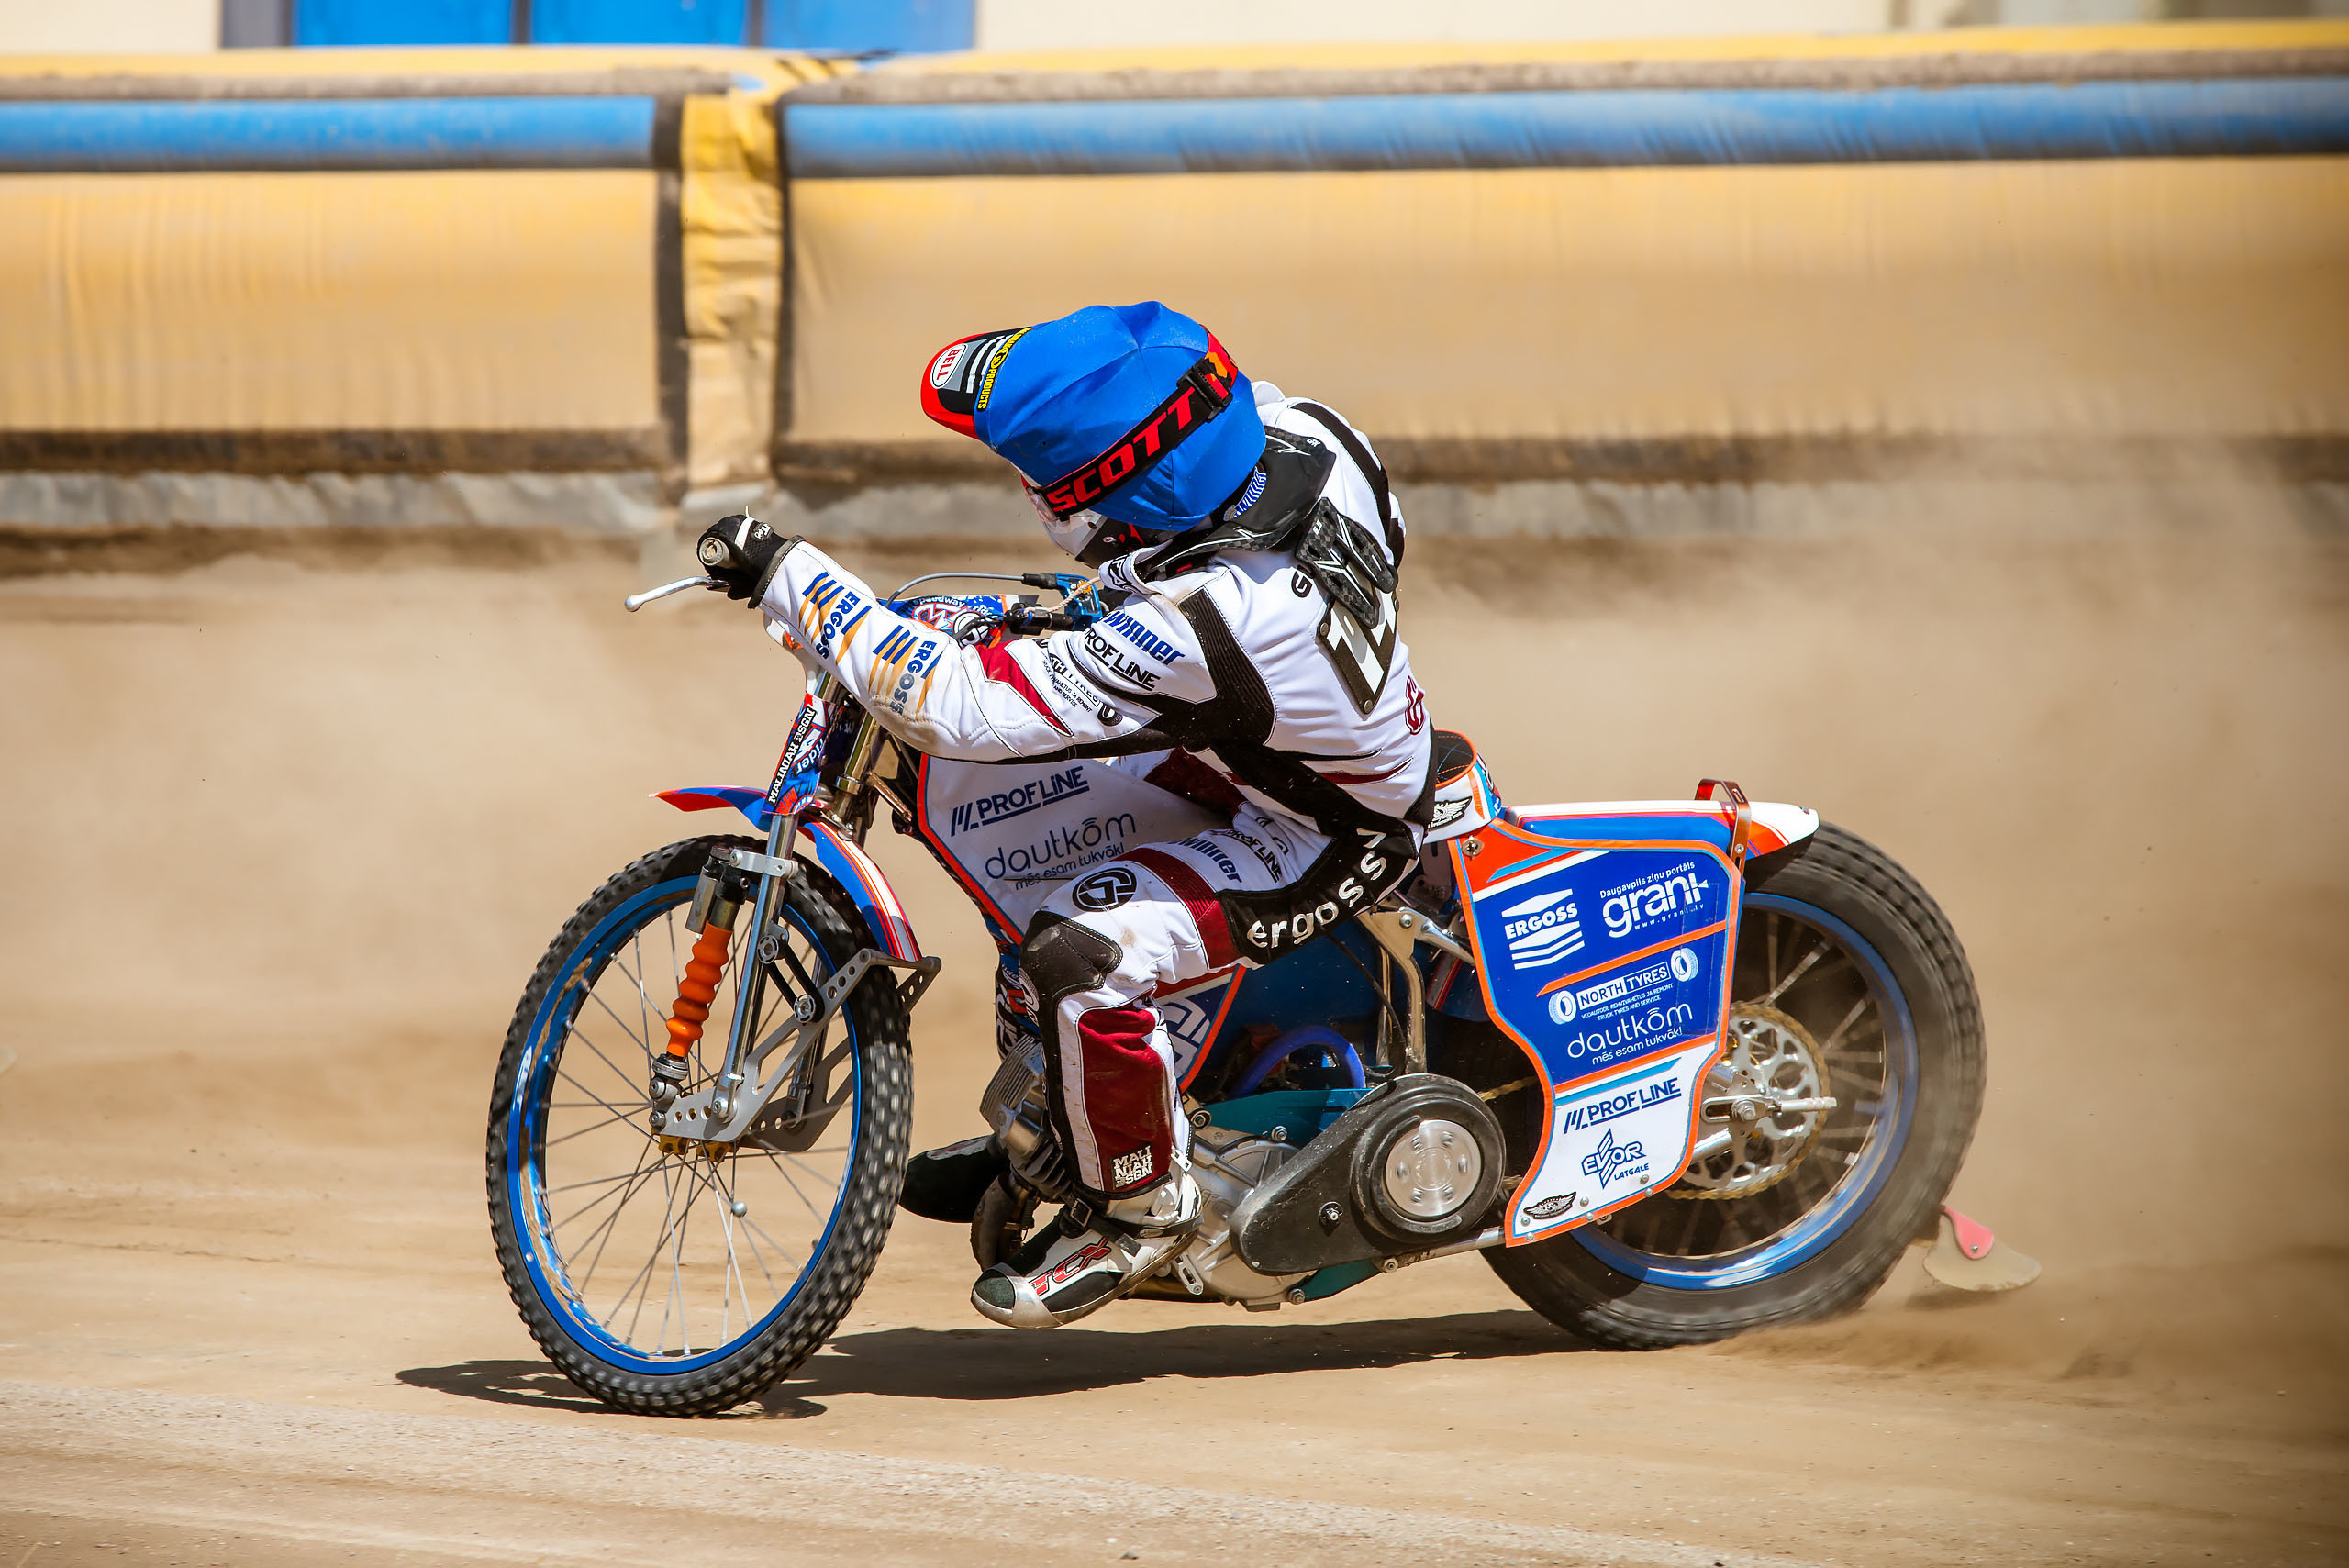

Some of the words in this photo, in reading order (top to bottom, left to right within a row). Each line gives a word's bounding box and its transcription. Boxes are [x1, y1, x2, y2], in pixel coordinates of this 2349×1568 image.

[936, 348, 962, 381] BELL
[977, 368, 997, 409] PRODUCTS
[1046, 386, 1196, 513] SCOTT
[816, 591, 861, 660] ERGOSS
[1103, 610, 1186, 666] winner
[1015, 872, 1041, 891] mēs
[1042, 860, 1077, 878] esam
[1078, 841, 1125, 867] tukvāk!
[1599, 877, 1646, 899] Daugavpils
[1665, 861, 1696, 878] portāls
[1504, 902, 1578, 940] ERGOSS
[1579, 981, 1624, 1006] NORTH
[1626, 965, 1669, 990] TYRES
[1592, 1049, 1614, 1065] mēs
[1615, 1040, 1644, 1058] esam
[1645, 1027, 1683, 1048] tukvāk!
[1581, 1128, 1647, 1189] EVOR
[1613, 1162, 1650, 1181] LATGALE
